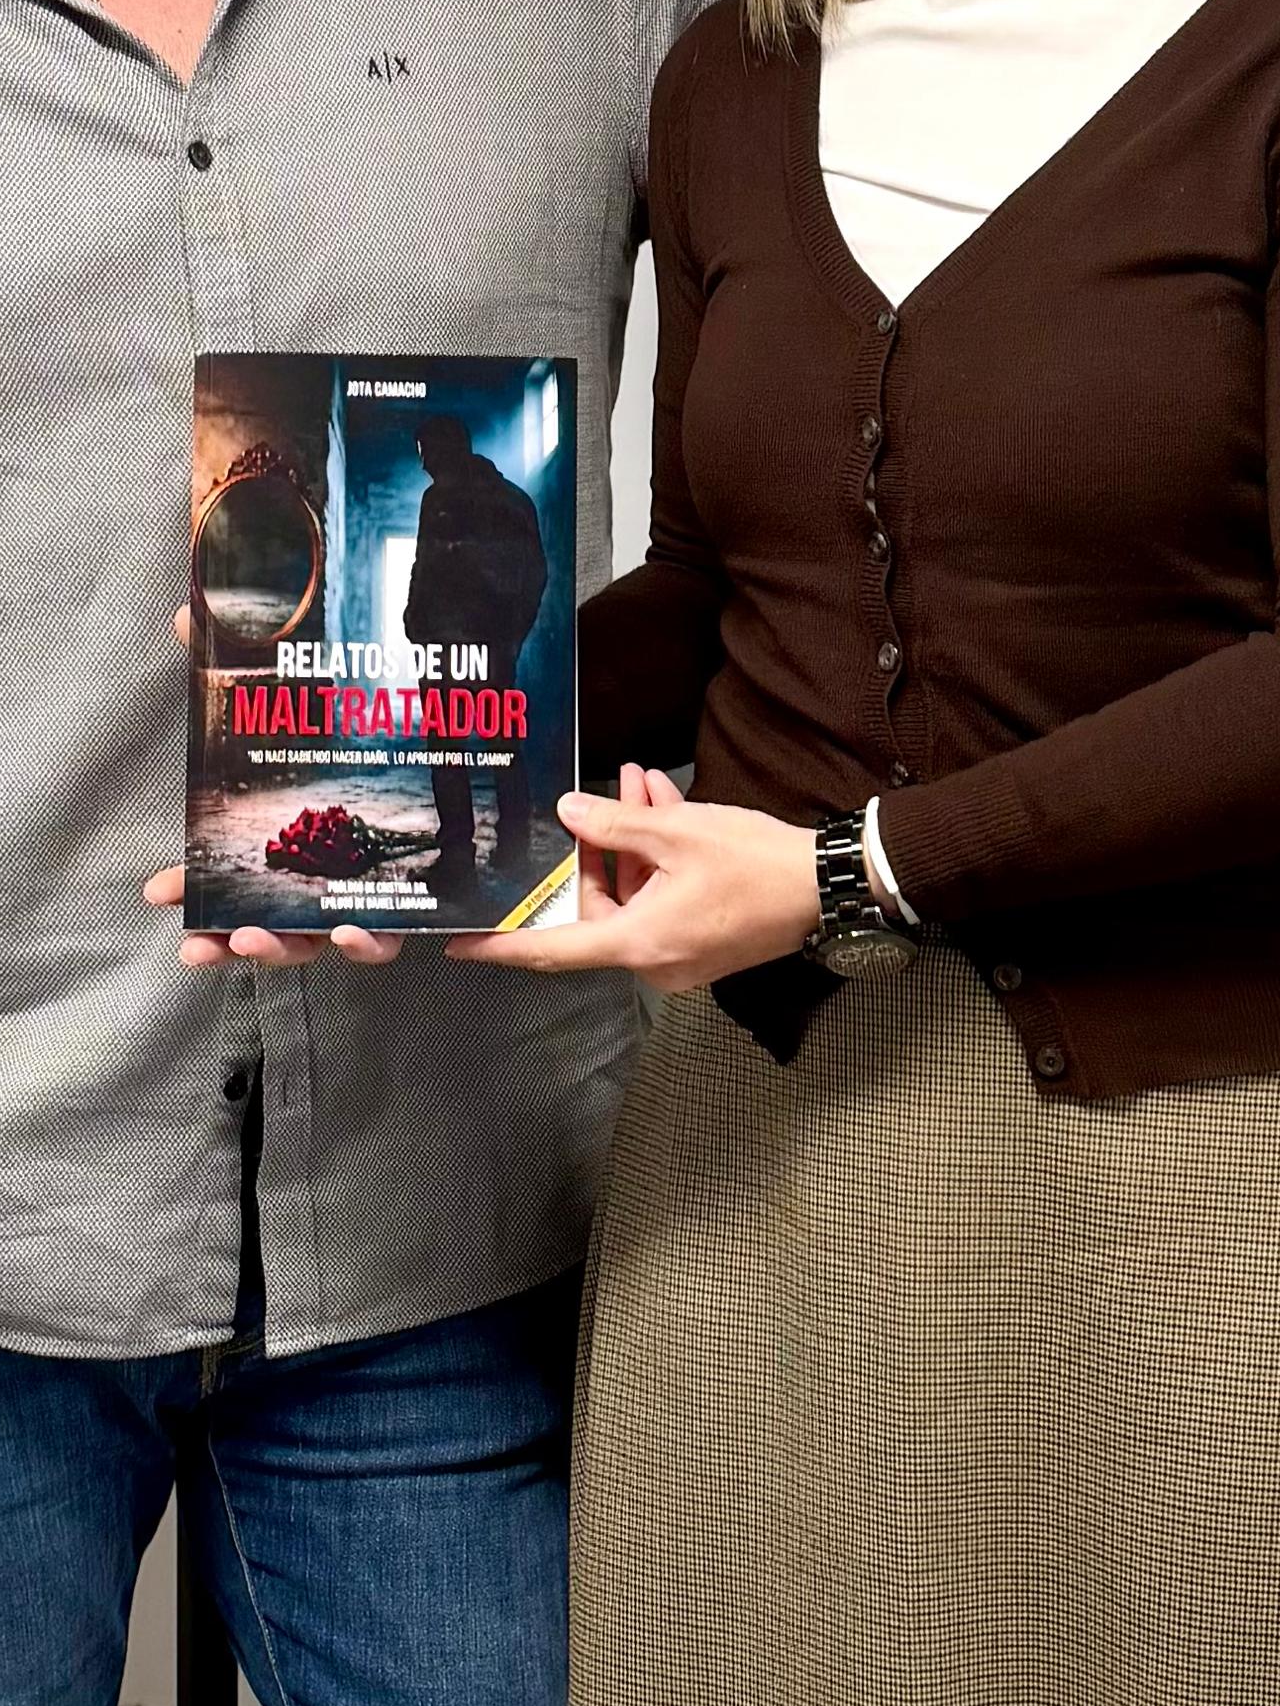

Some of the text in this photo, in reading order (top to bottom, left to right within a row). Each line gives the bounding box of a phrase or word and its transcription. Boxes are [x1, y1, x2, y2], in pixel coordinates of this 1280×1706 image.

[347, 380, 426, 398] JOTA CAMACHO
[277, 641, 488, 681] RELATOS DE UN
[233, 685, 527, 739] MALTRATADOR
[332, 750, 361, 764] HACER
[393, 751, 405, 765] LO
[445, 752, 463, 765] POR
[465, 752, 475, 766] EL
